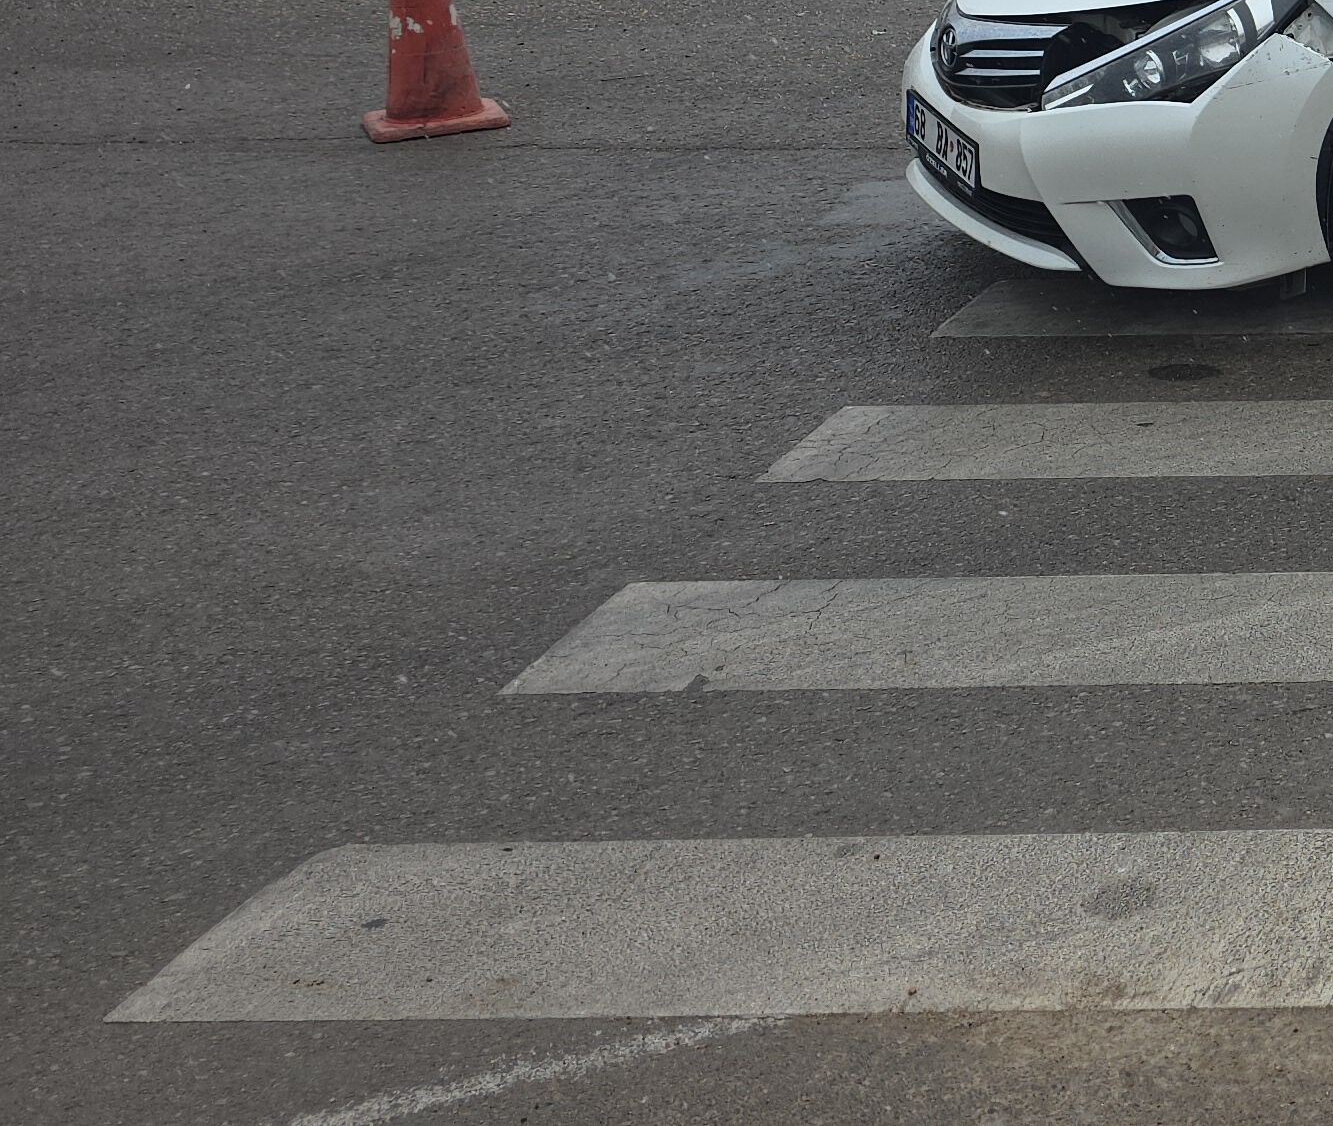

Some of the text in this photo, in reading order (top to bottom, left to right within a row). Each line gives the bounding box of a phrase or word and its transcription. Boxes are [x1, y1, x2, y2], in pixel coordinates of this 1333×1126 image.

[914, 103, 926, 141] 68
[936, 120, 949, 162] BA
[955, 138, 974, 181] 857
